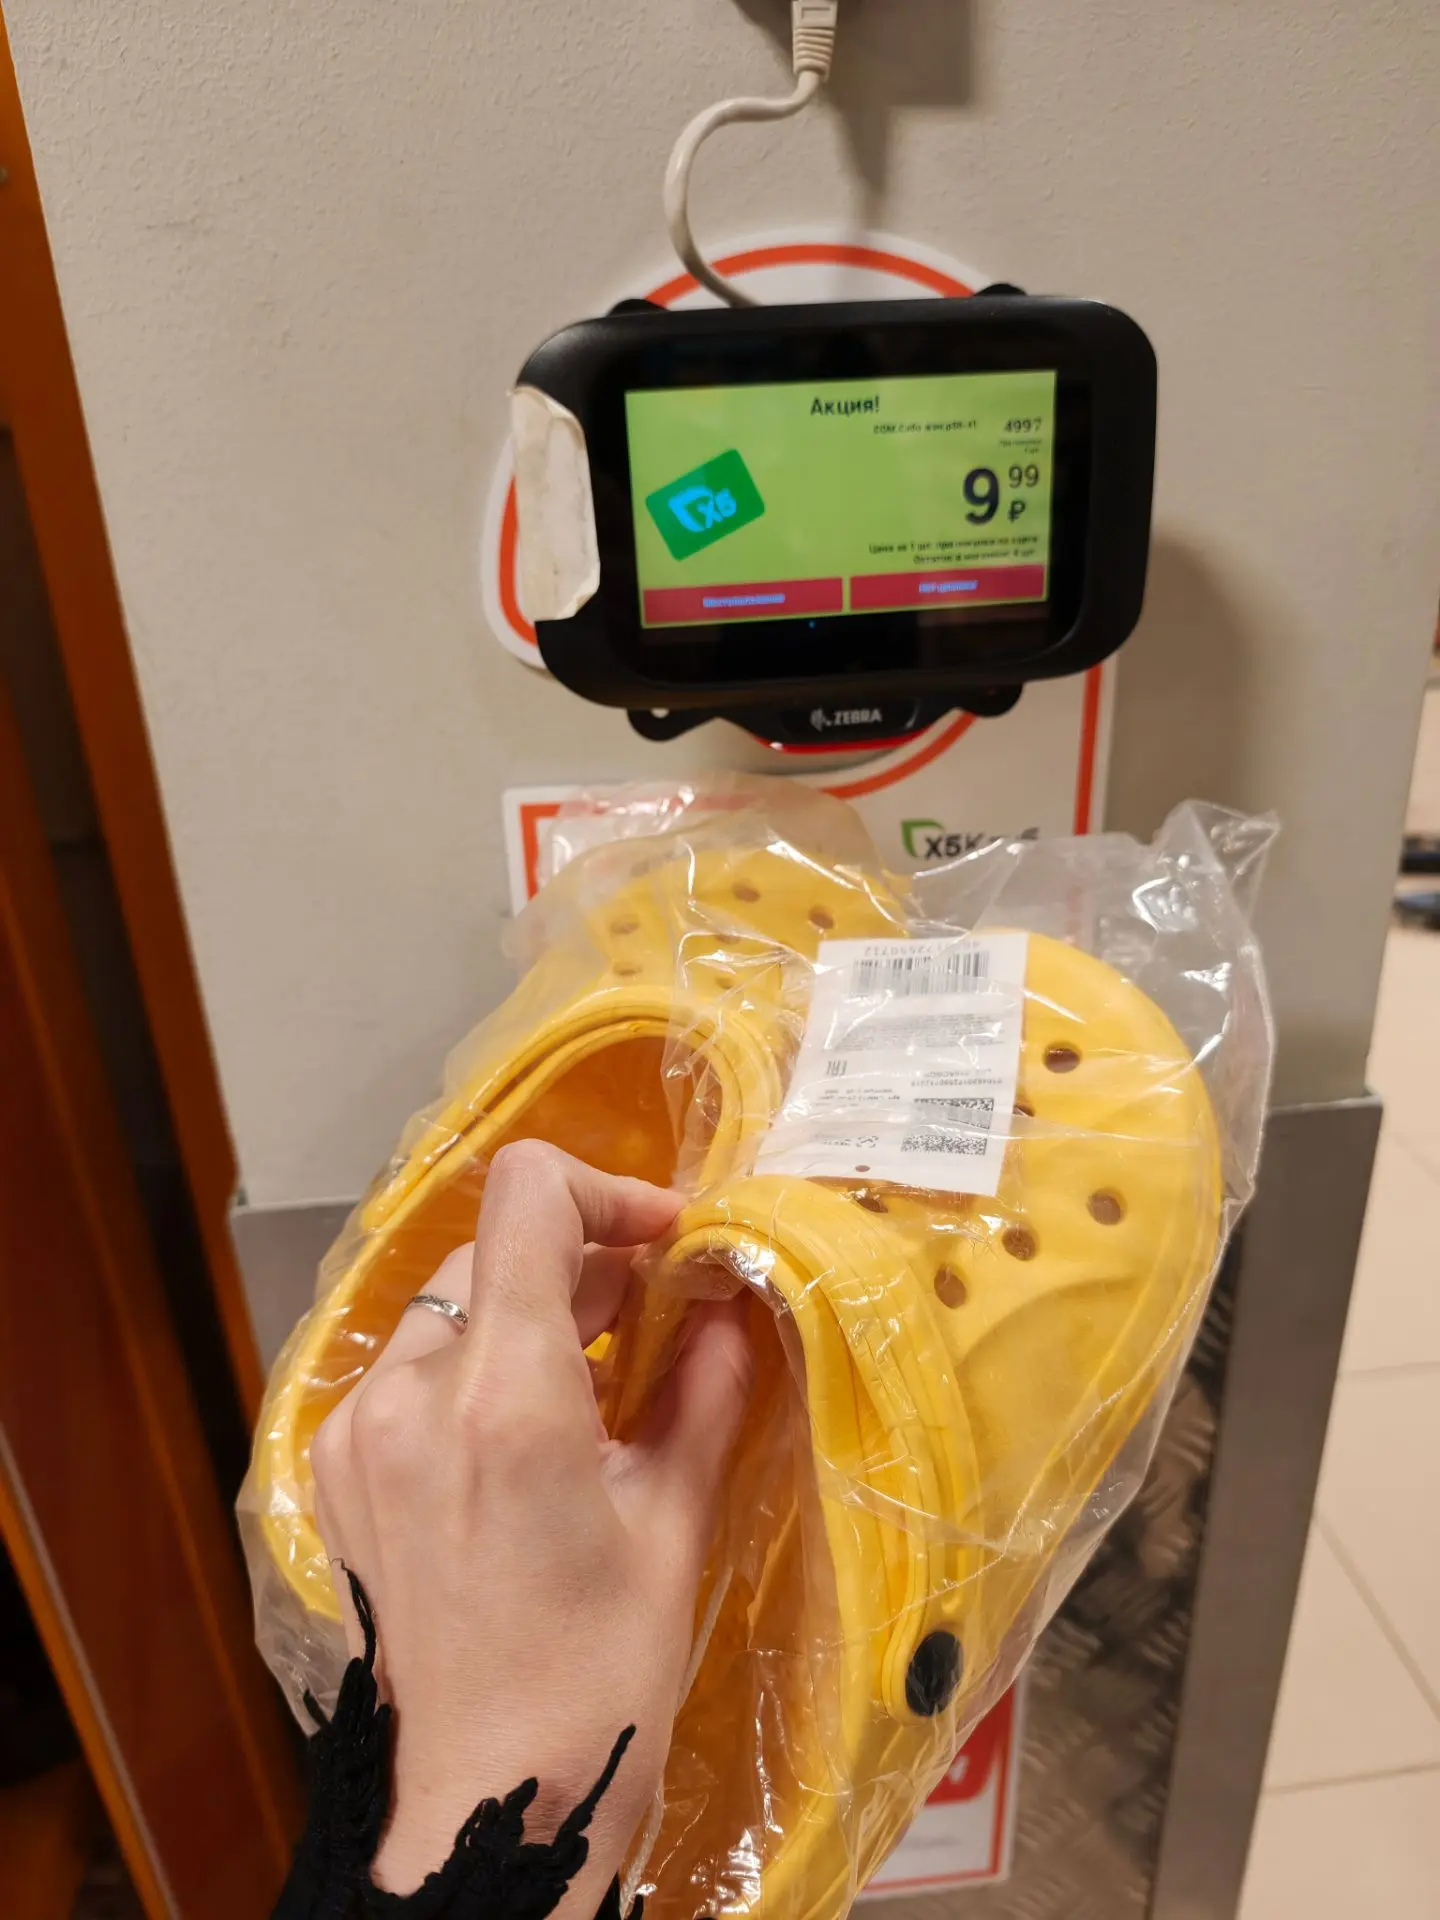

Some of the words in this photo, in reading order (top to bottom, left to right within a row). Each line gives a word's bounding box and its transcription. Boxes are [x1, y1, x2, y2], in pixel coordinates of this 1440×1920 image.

[810, 396, 880, 417] Акция!
[963, 467, 1000, 526] 9
[1008, 464, 1040, 488] 99
[834, 708, 882, 726] ZEBRA
